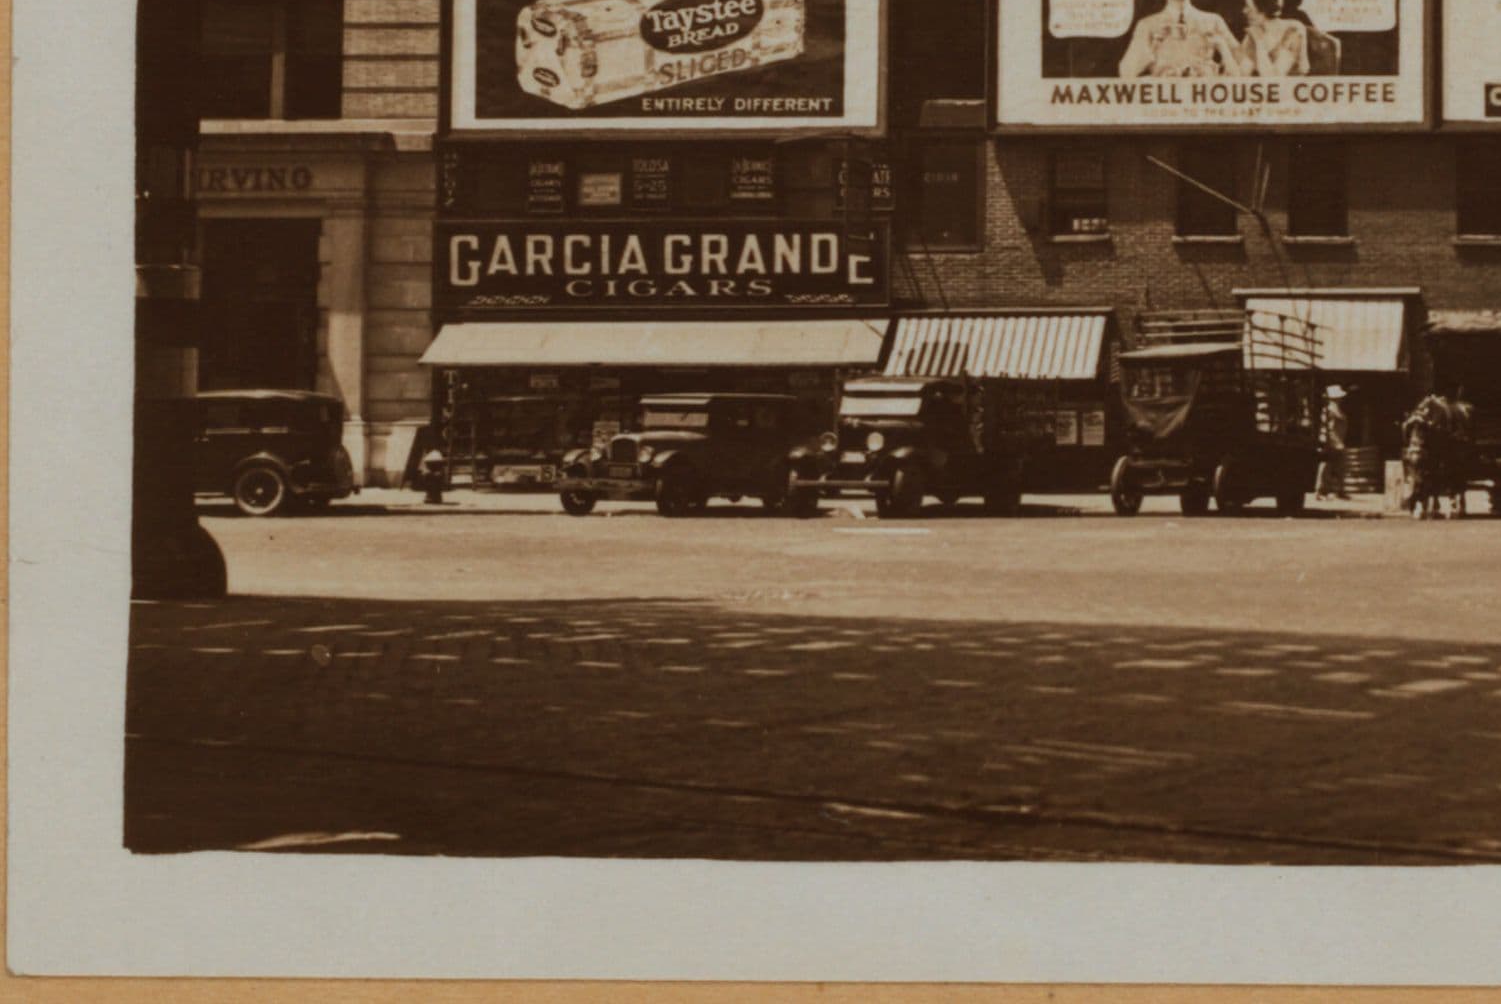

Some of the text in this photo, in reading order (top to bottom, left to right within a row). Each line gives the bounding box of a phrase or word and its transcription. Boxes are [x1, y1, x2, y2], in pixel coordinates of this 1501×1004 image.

[667, 22, 740, 48] BREAD
[659, 47, 748, 85] SLICED
[641, 96, 834, 112] ENTIRELY DIFFERENT
[1050, 81, 1397, 105] MAXWELL HOUSE COFFEE
[449, 232, 650, 288] GARCIA
[564, 279, 774, 297] CIGARS
